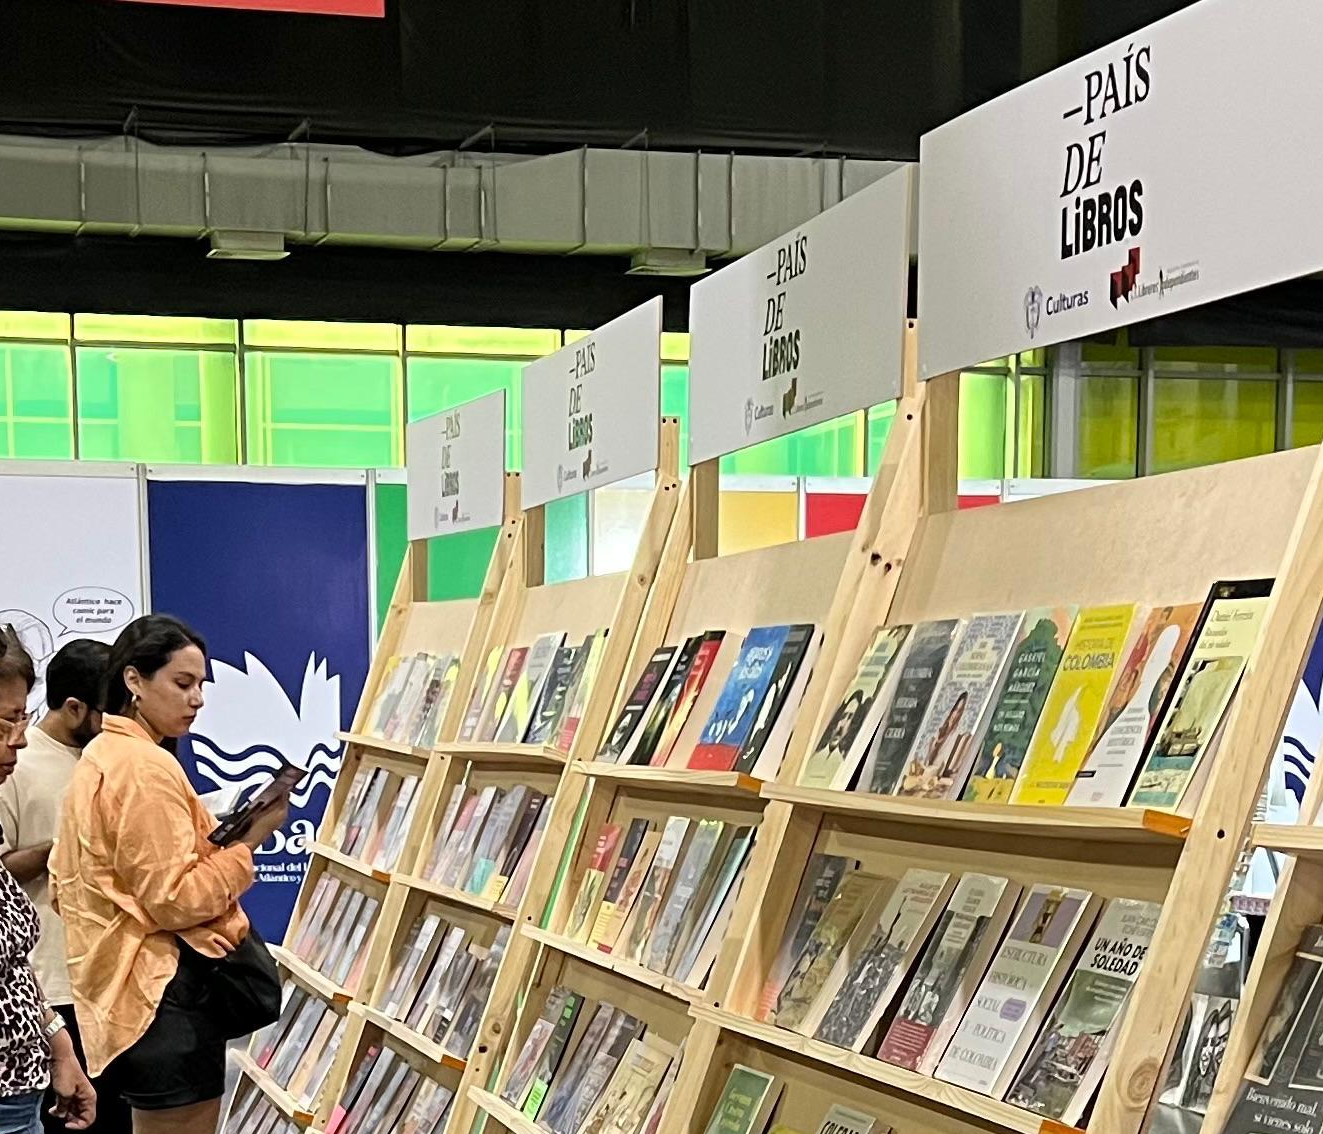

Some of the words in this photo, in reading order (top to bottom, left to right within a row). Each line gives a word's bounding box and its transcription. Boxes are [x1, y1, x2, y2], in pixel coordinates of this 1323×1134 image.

[1061, 131, 1106, 198] DE
[763, 291, 786, 336] DE
[1046, 290, 1089, 315] Culturas
[568, 384, 583, 417] DE
[1063, 652, 1114, 671] COLOMBIA
[1094, 936, 1109, 951] UN
[1108, 937, 1131, 957] AÑO
[1132, 945, 1148, 961] DE
[1090, 953, 1139, 976] SOLEDAD
